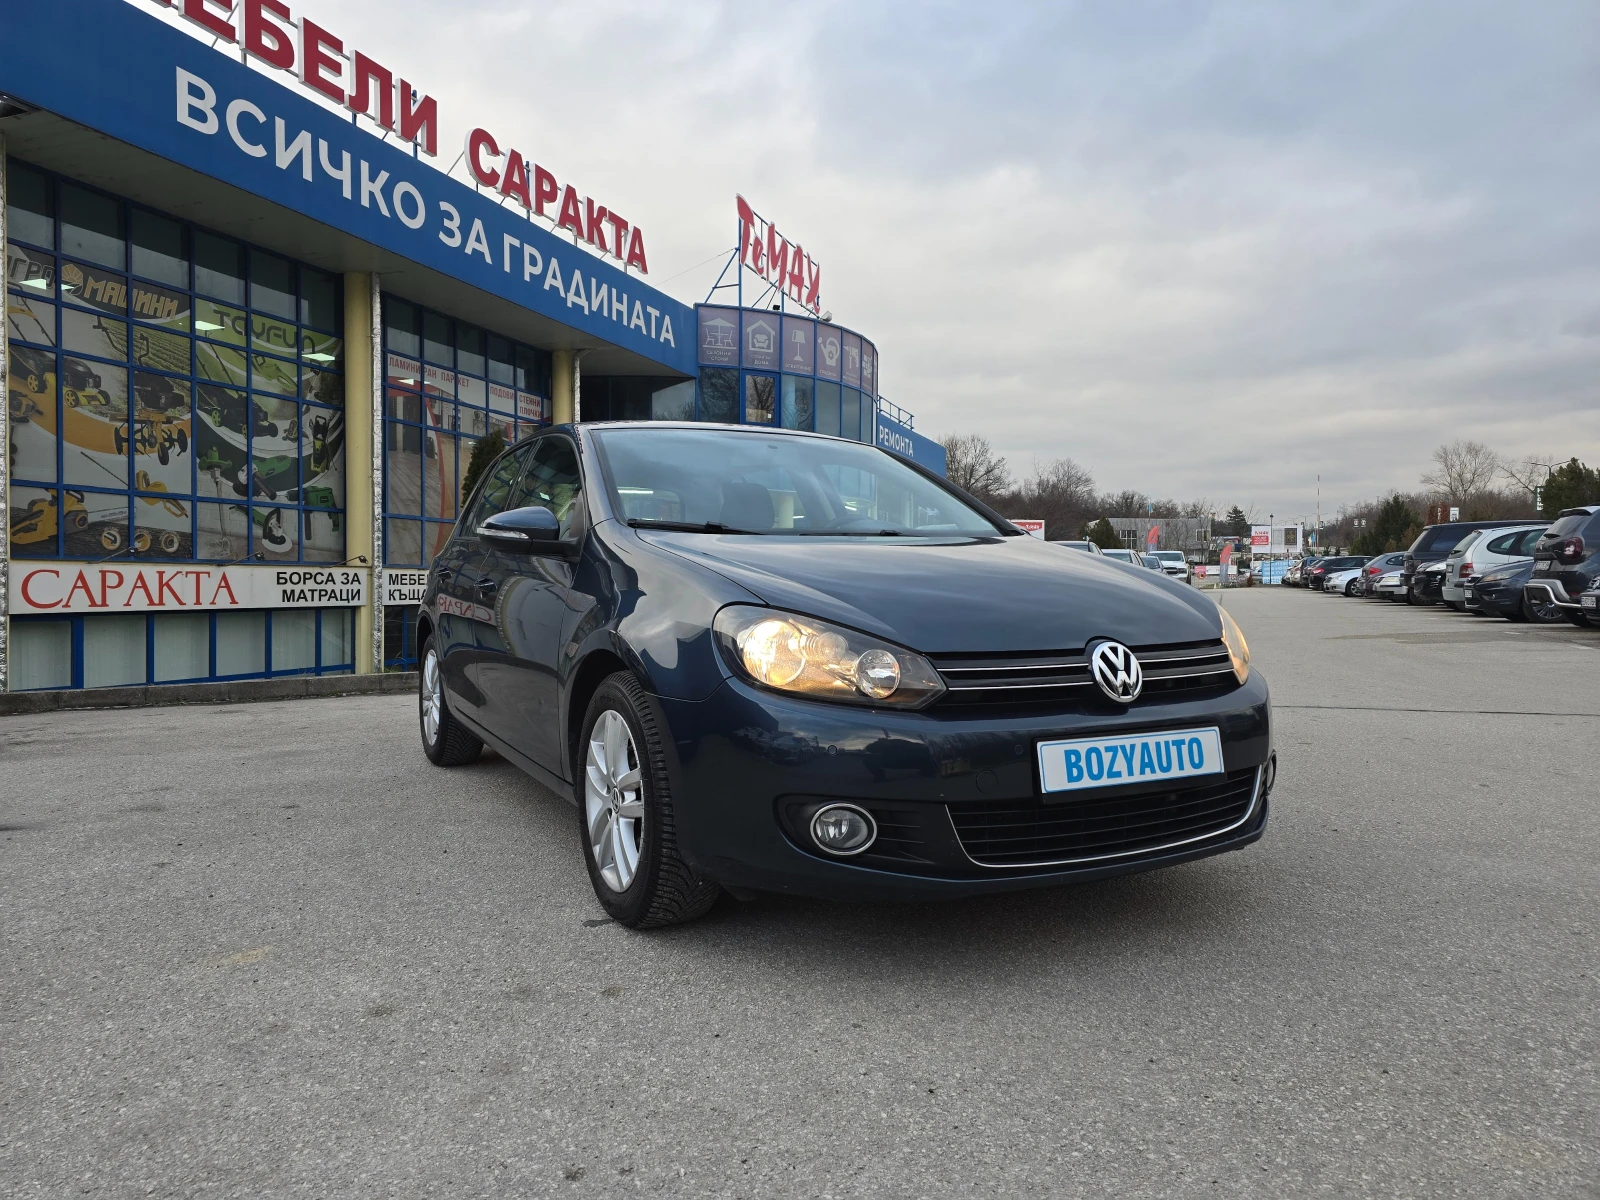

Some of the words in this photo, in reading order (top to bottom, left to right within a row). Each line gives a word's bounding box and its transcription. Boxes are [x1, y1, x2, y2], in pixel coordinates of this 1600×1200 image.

[175, 66, 426, 229] ВСИЧКО
[439, 201, 492, 265] ЗА
[503, 233, 676, 348] ГРАДИНАТА
[464, 127, 649, 274] САРАКТА
[84, 276, 179, 320] МАШИНИ
[389, 357, 437, 379] ЛАМИНИРАН
[489, 386, 514, 401] ПОДОВИ
[879, 425, 914, 457] РЕМОНТА
[21, 569, 239, 609] САРАКТА
[276, 571, 337, 586] БОРСА
[340, 572, 362, 586] ЗА
[389, 573, 428, 586] МЕБЕ
[281, 588, 361, 604] МАТРАЦИ
[1063, 737, 1204, 784] BOZYAUTO
